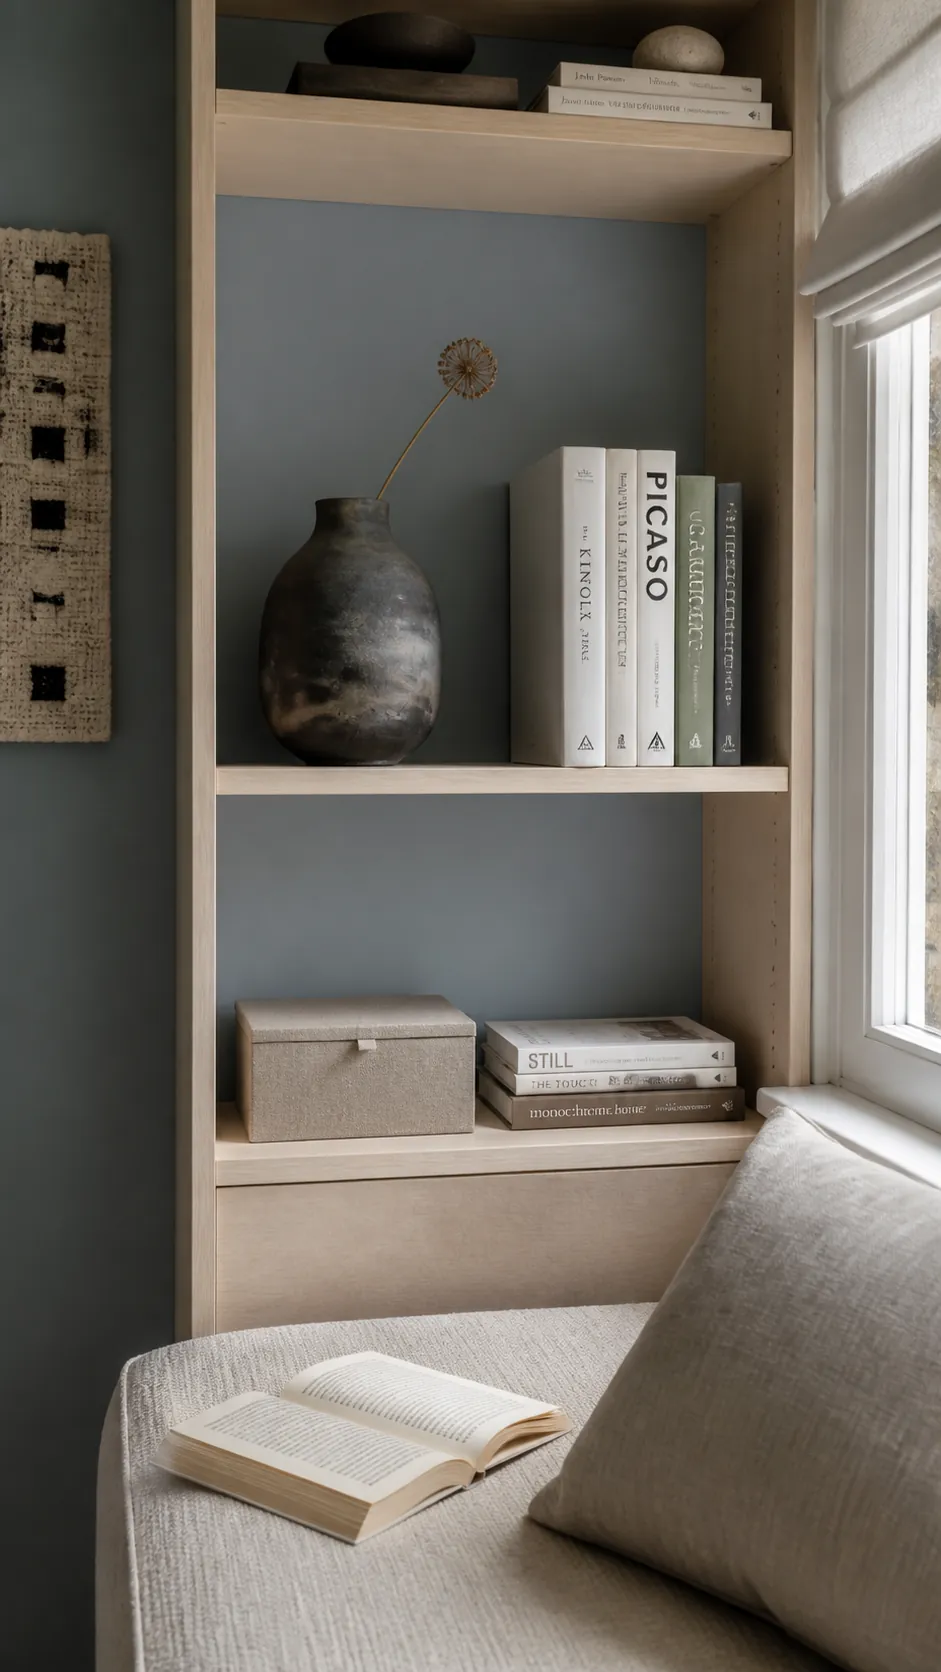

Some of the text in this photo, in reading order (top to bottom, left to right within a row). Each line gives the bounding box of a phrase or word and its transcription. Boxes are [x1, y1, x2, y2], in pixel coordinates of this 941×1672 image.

[646, 471, 669, 602] PICASO
[528, 1052, 574, 1070] STILL
[531, 1080, 552, 1090] THE
